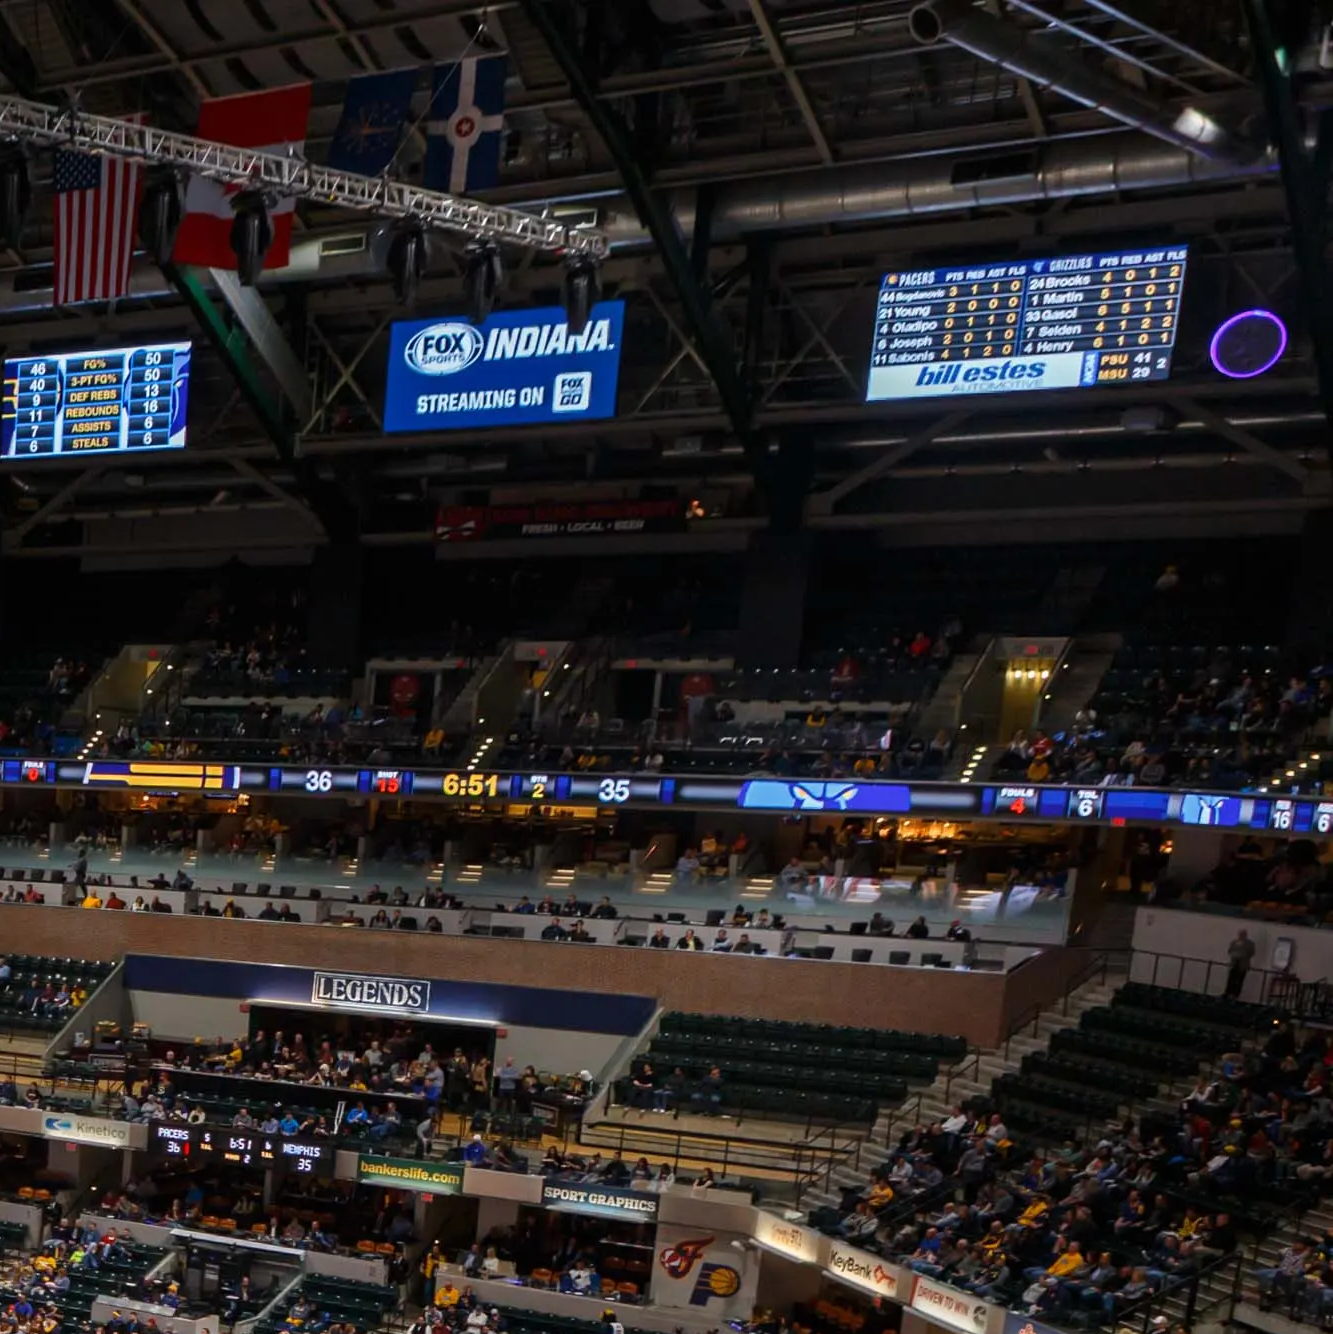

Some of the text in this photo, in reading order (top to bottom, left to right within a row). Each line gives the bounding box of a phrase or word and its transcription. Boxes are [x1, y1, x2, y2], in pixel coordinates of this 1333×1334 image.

[898, 271, 936, 287] PACERS
[1045, 275, 1091, 288] Brooks
[1043, 292, 1084, 305] Martin
[893, 305, 932, 319] Young
[1041, 307, 1079, 321] Gasol
[892, 320, 938, 334] Oladipo
[423, 332, 466, 356] FOX
[483, 318, 612, 361] INDIANA
[889, 335, 933, 350] Joseph
[1036, 340, 1075, 354] Henry
[83, 359, 107, 370] FG%
[145, 352, 162, 365] 50
[887, 351, 935, 364] Sabonis
[1134, 352, 1152, 364] 41
[29, 378, 45, 391] 40
[94, 374, 117, 385] FG%
[144, 369, 161, 381] 50
[915, 359, 1046, 387] bill estes
[560, 377, 585, 390] FOX
[70, 385, 159, 402] DEF REBS 13
[416, 386, 546, 415] STREAMING ON
[560, 393, 583, 405] GO
[29, 410, 43, 422] 11
[65, 404, 120, 419] REBOUNDS
[71, 421, 112, 433] ASSISTS
[72, 437, 109, 449] STEALS
[305, 770, 333, 793] 36
[377, 778, 399, 793] 15
[442, 773, 499, 797] 6:51
[598, 779, 630, 801] 35
[1273, 811, 1290, 830] 16
[318, 977, 422, 1007] LEGENDS
[77, 1119, 126, 1139] Kinetico
[158, 1127, 190, 1141] PACERS
[229, 1138, 252, 1150] 6:51
[167, 1141, 181, 1154] 36
[297, 1159, 312, 1171] 35
[361, 1160, 460, 1184] bankerslife.com
[544, 1187, 657, 1212] SPORT GRAPHICS
[829, 1249, 872, 1281] KeyBank
[918, 1285, 970, 1317] DRIVEN TO WIN
